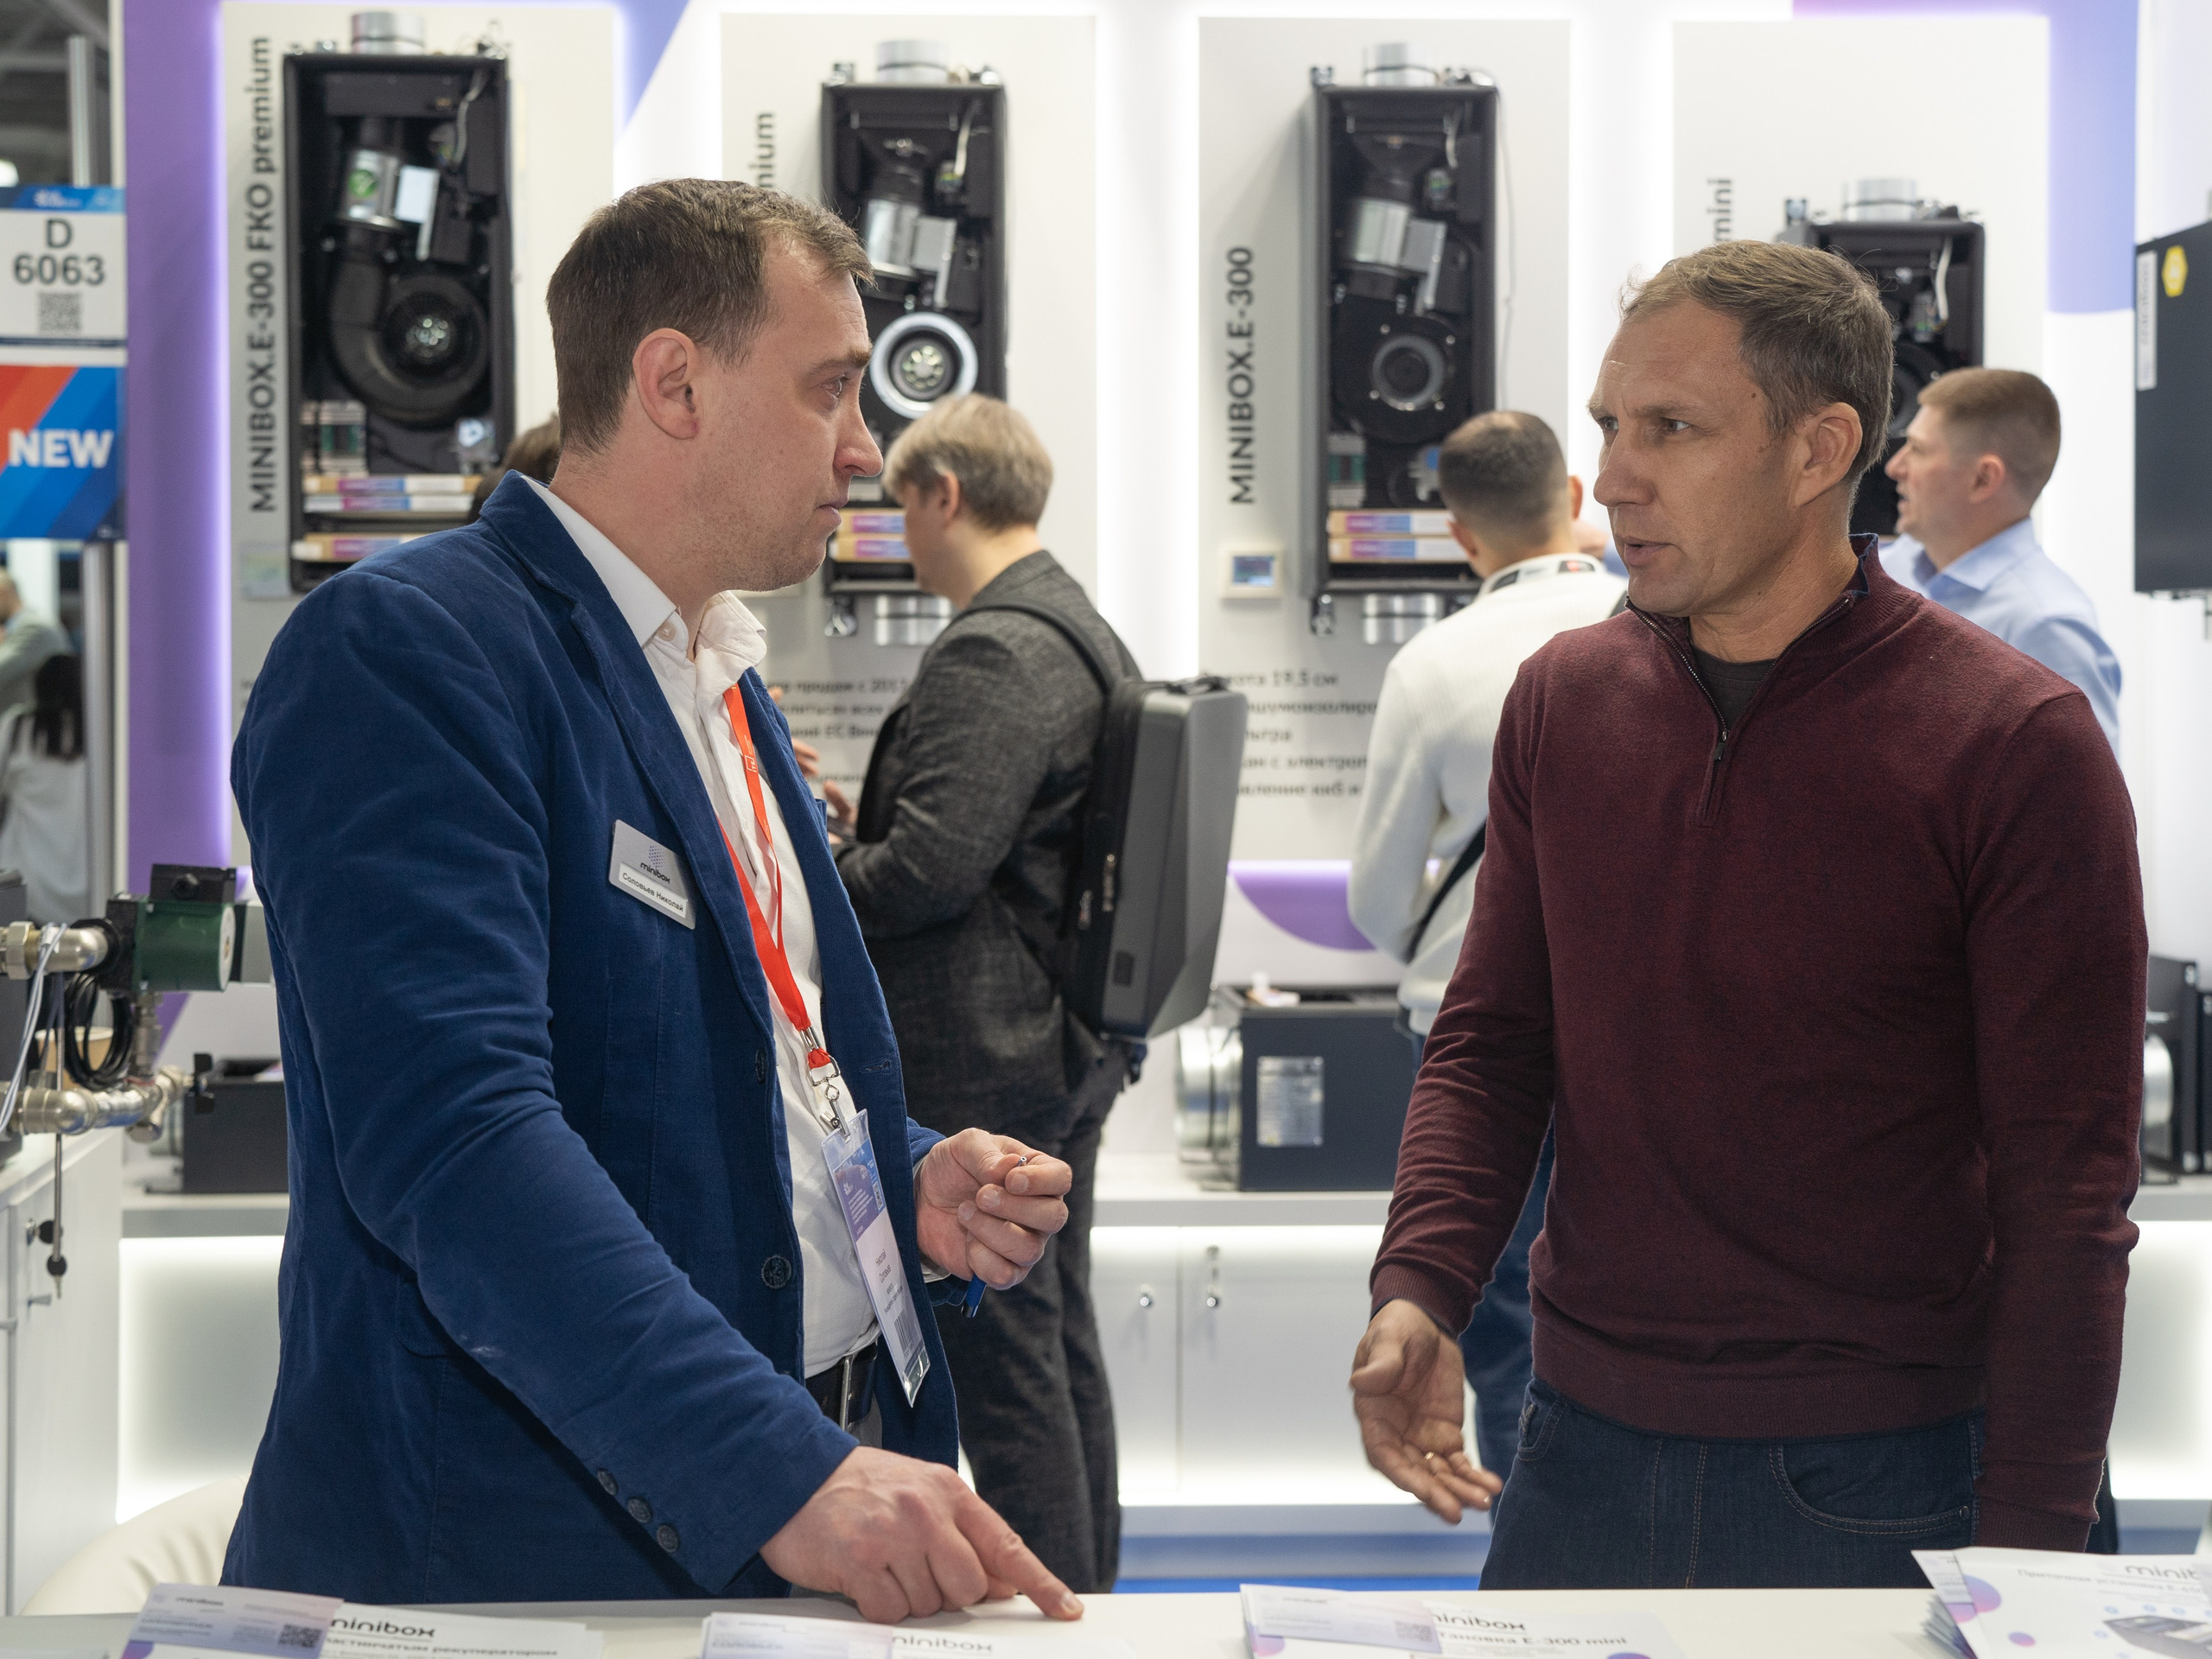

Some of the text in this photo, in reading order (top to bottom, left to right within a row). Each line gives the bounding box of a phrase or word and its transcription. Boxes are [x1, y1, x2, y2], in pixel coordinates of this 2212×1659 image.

[747, 112, 774, 188] mium
[45, 218, 73, 249] D
[13, 253, 105, 286] 6063
[245, 37, 276, 512] MINIBOX.E-300 FKO premium
[1225, 246, 1255, 505] MINIBOX.E-300
[8, 429, 114, 468] NEW
[622, 872, 684, 912] Соловьев Николай
[640, 862, 671, 884] minibox
[1440, 1631, 1516, 1645] тановка
